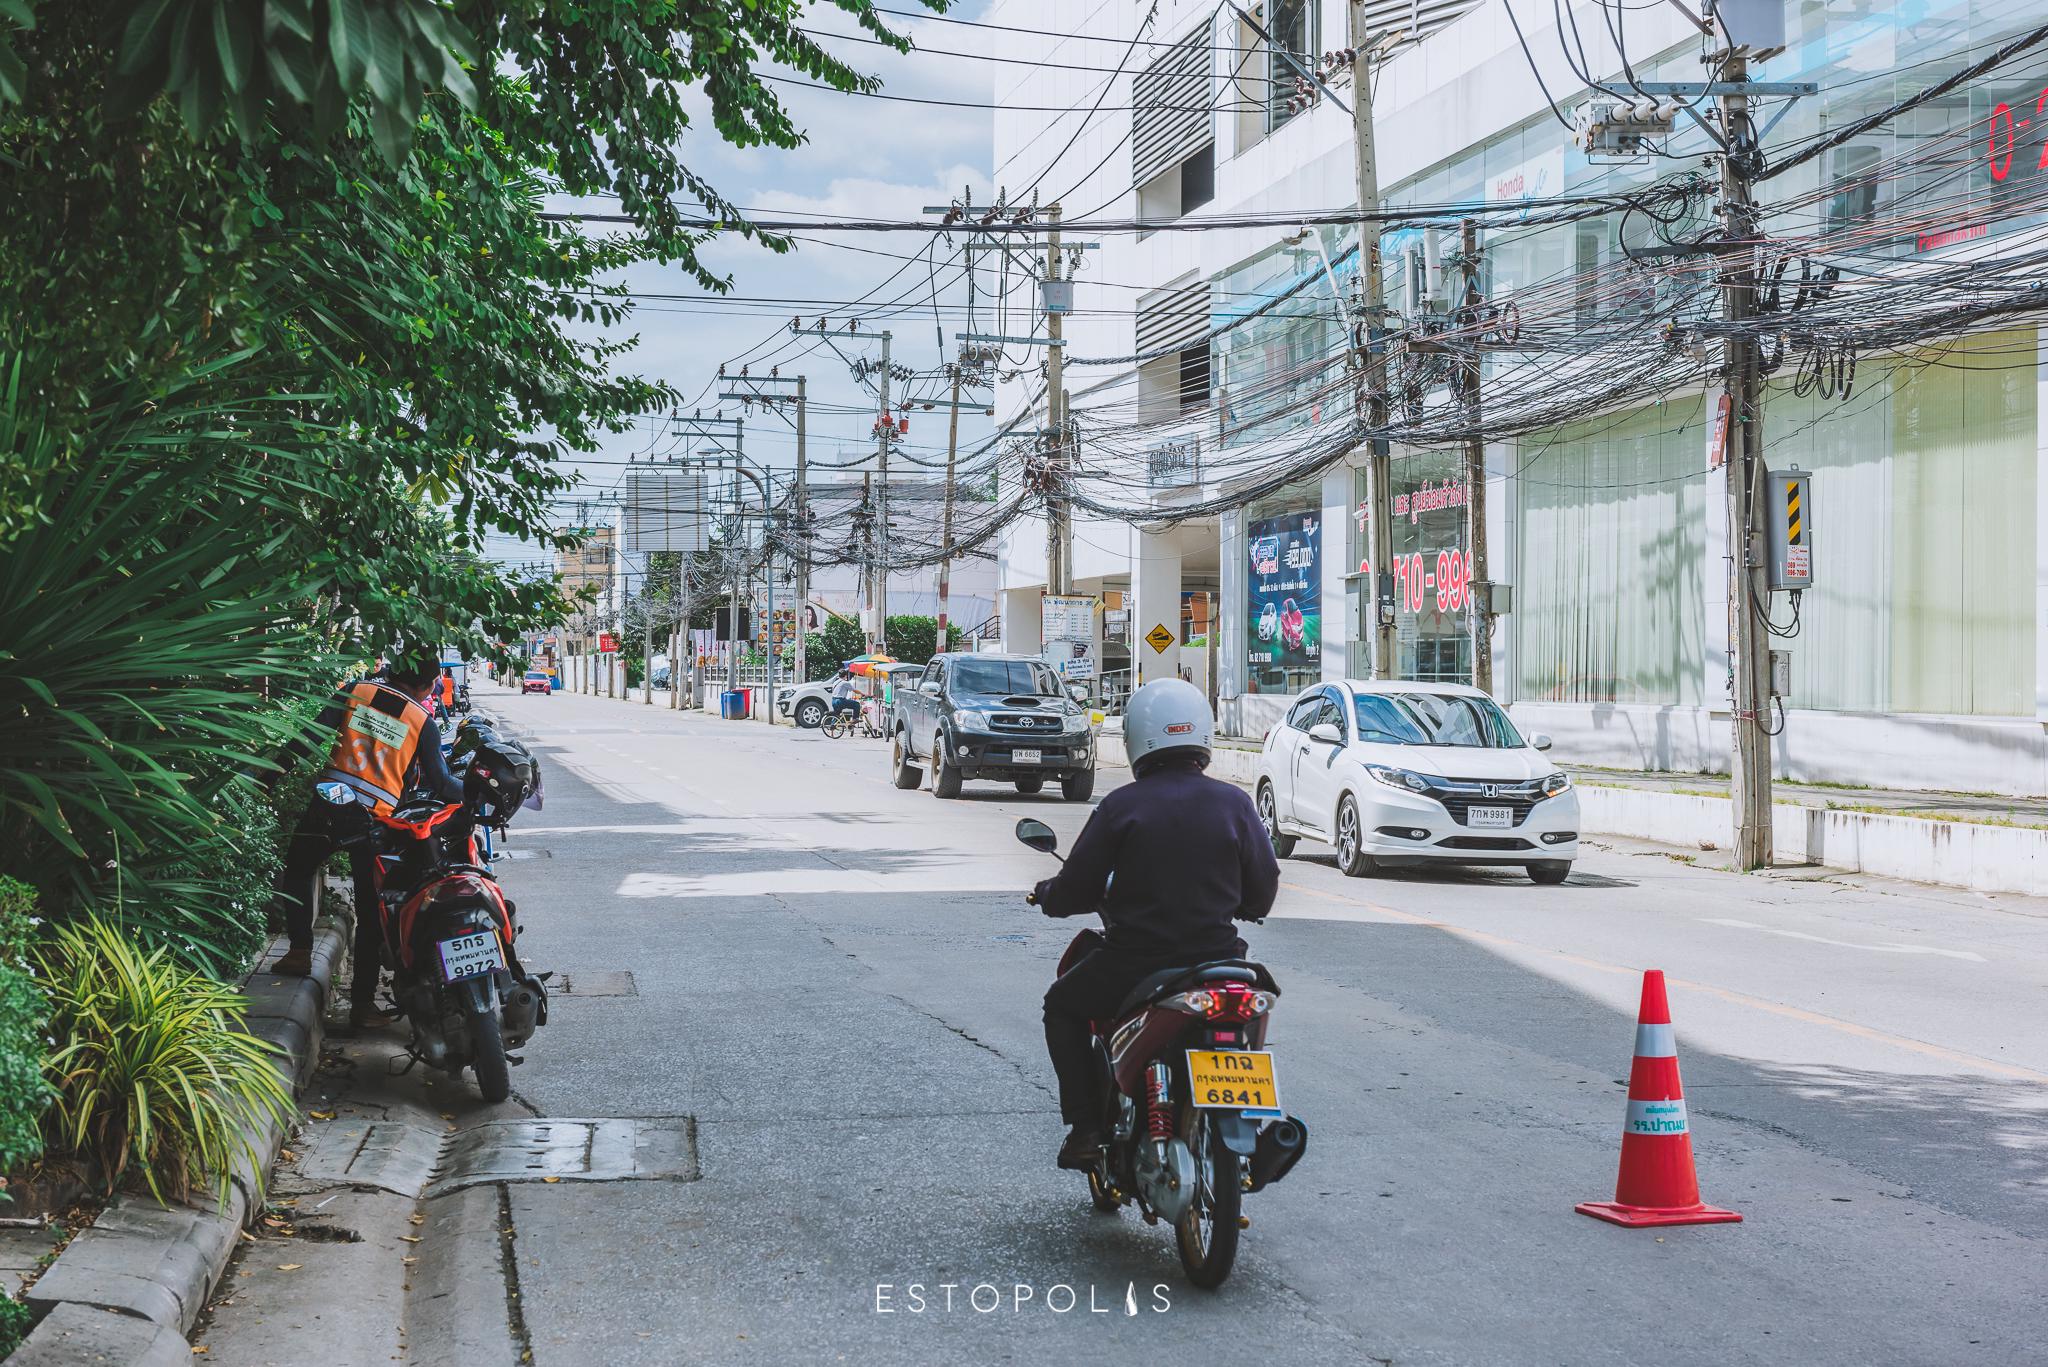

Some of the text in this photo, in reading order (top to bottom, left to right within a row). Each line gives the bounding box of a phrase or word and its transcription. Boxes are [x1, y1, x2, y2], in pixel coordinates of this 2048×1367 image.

[1497, 173, 1524, 200] Honda
[1167, 723, 1193, 733] INDEX
[1490, 809, 1510, 819] 9981
[451, 934, 485, 952] 5กธ
[445, 946, 499, 966] กรุงเทพมหานคร
[454, 959, 496, 978] 9972
[1196, 1074, 1271, 1086] กรุงเทพมหานคร
[1206, 1088, 1263, 1106] 6841
